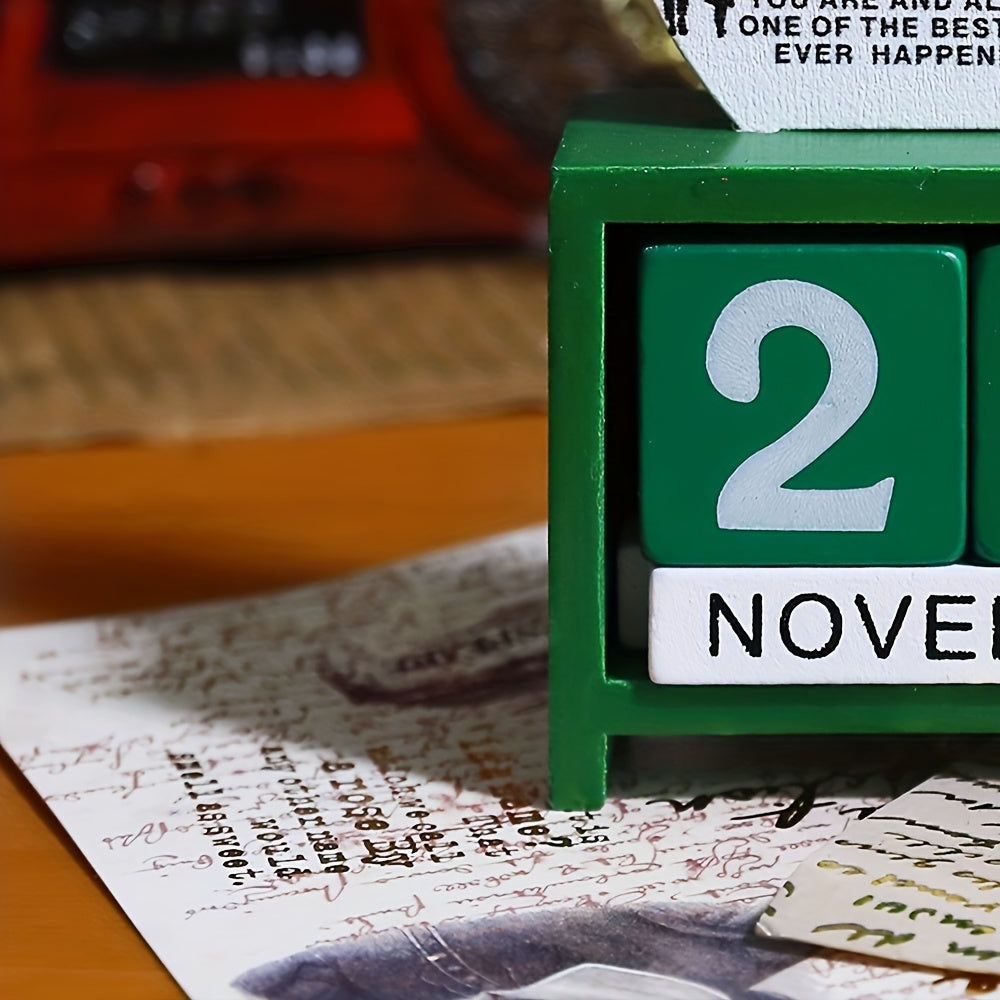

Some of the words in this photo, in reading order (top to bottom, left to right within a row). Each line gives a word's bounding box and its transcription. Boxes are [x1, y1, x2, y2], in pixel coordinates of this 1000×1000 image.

[739, 15, 801, 37] ONE
[811, 16, 851, 37] OF
[860, 17, 918, 38] THE
[775, 43, 853, 64] EVER
